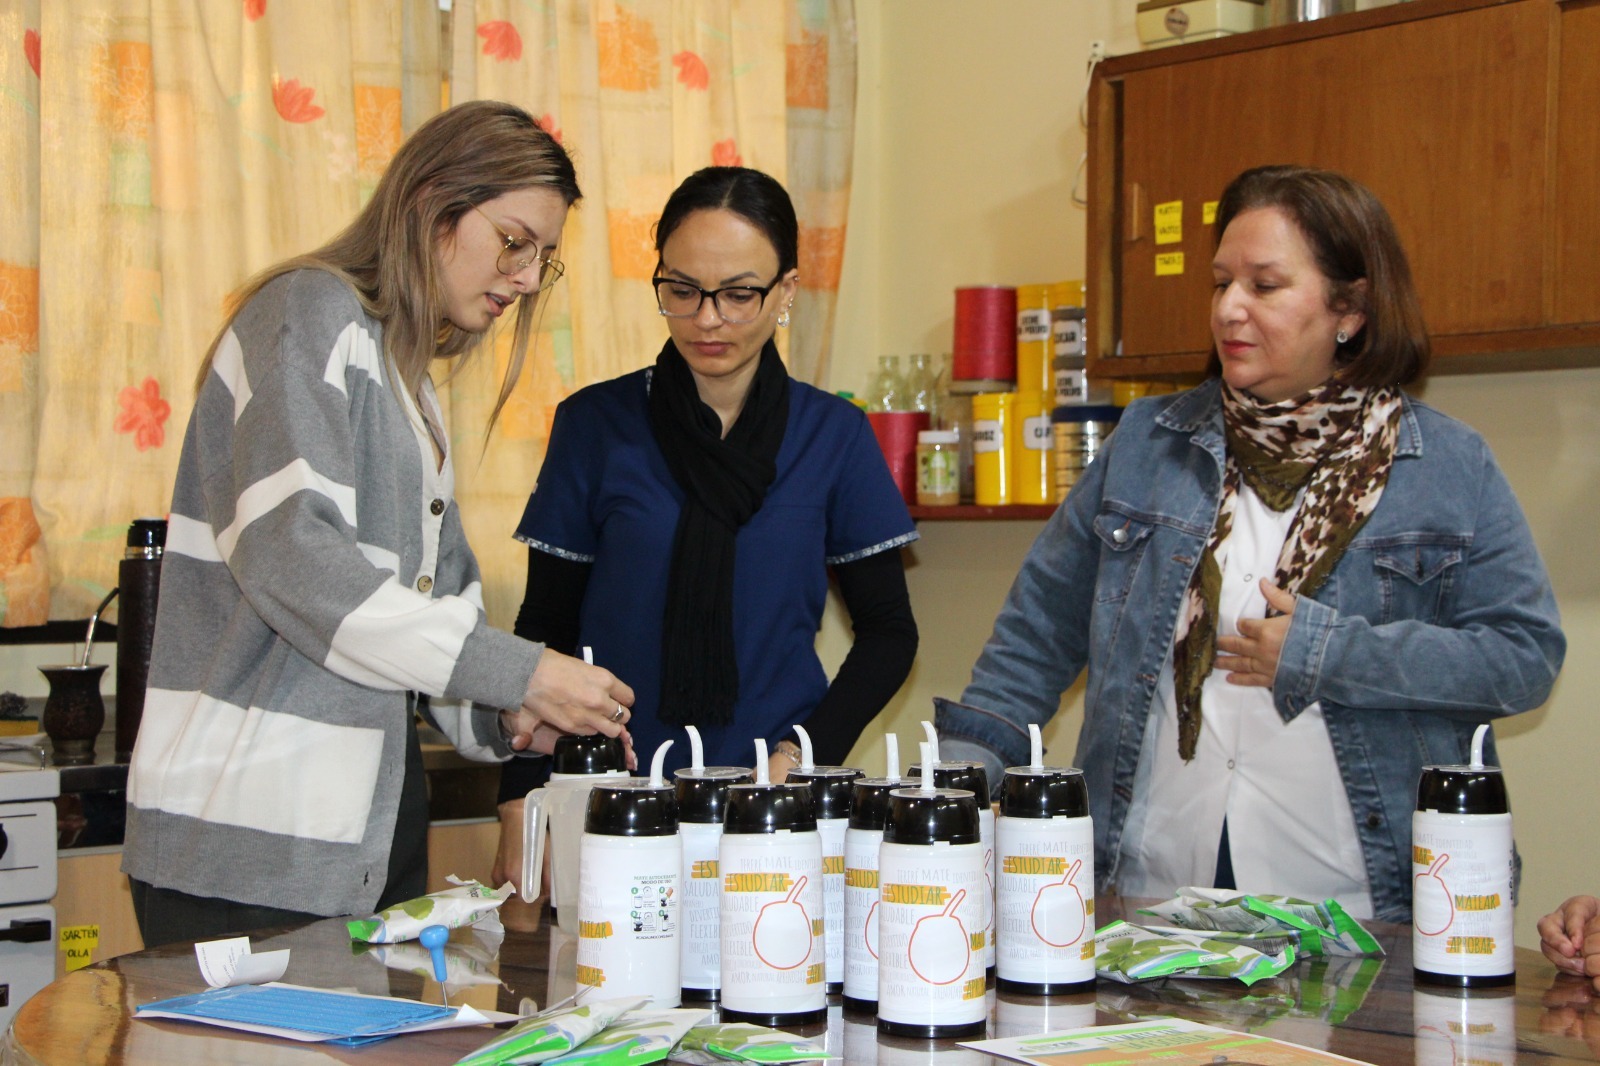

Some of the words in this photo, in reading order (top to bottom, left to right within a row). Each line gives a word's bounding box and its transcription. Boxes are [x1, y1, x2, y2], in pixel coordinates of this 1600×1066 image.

[1043, 841, 1069, 854] MATE
[764, 856, 792, 869] MATE
[1007, 856, 1063, 875] ESTUDIAR
[921, 867, 951, 882] MATE
[729, 874, 786, 892] ESTUDIAR
[886, 884, 944, 905] ESTUDIAR
[1454, 894, 1496, 910] MATEAR
[62, 925, 98, 942] SARTÉN
[67, 949, 89, 958] OLLA
